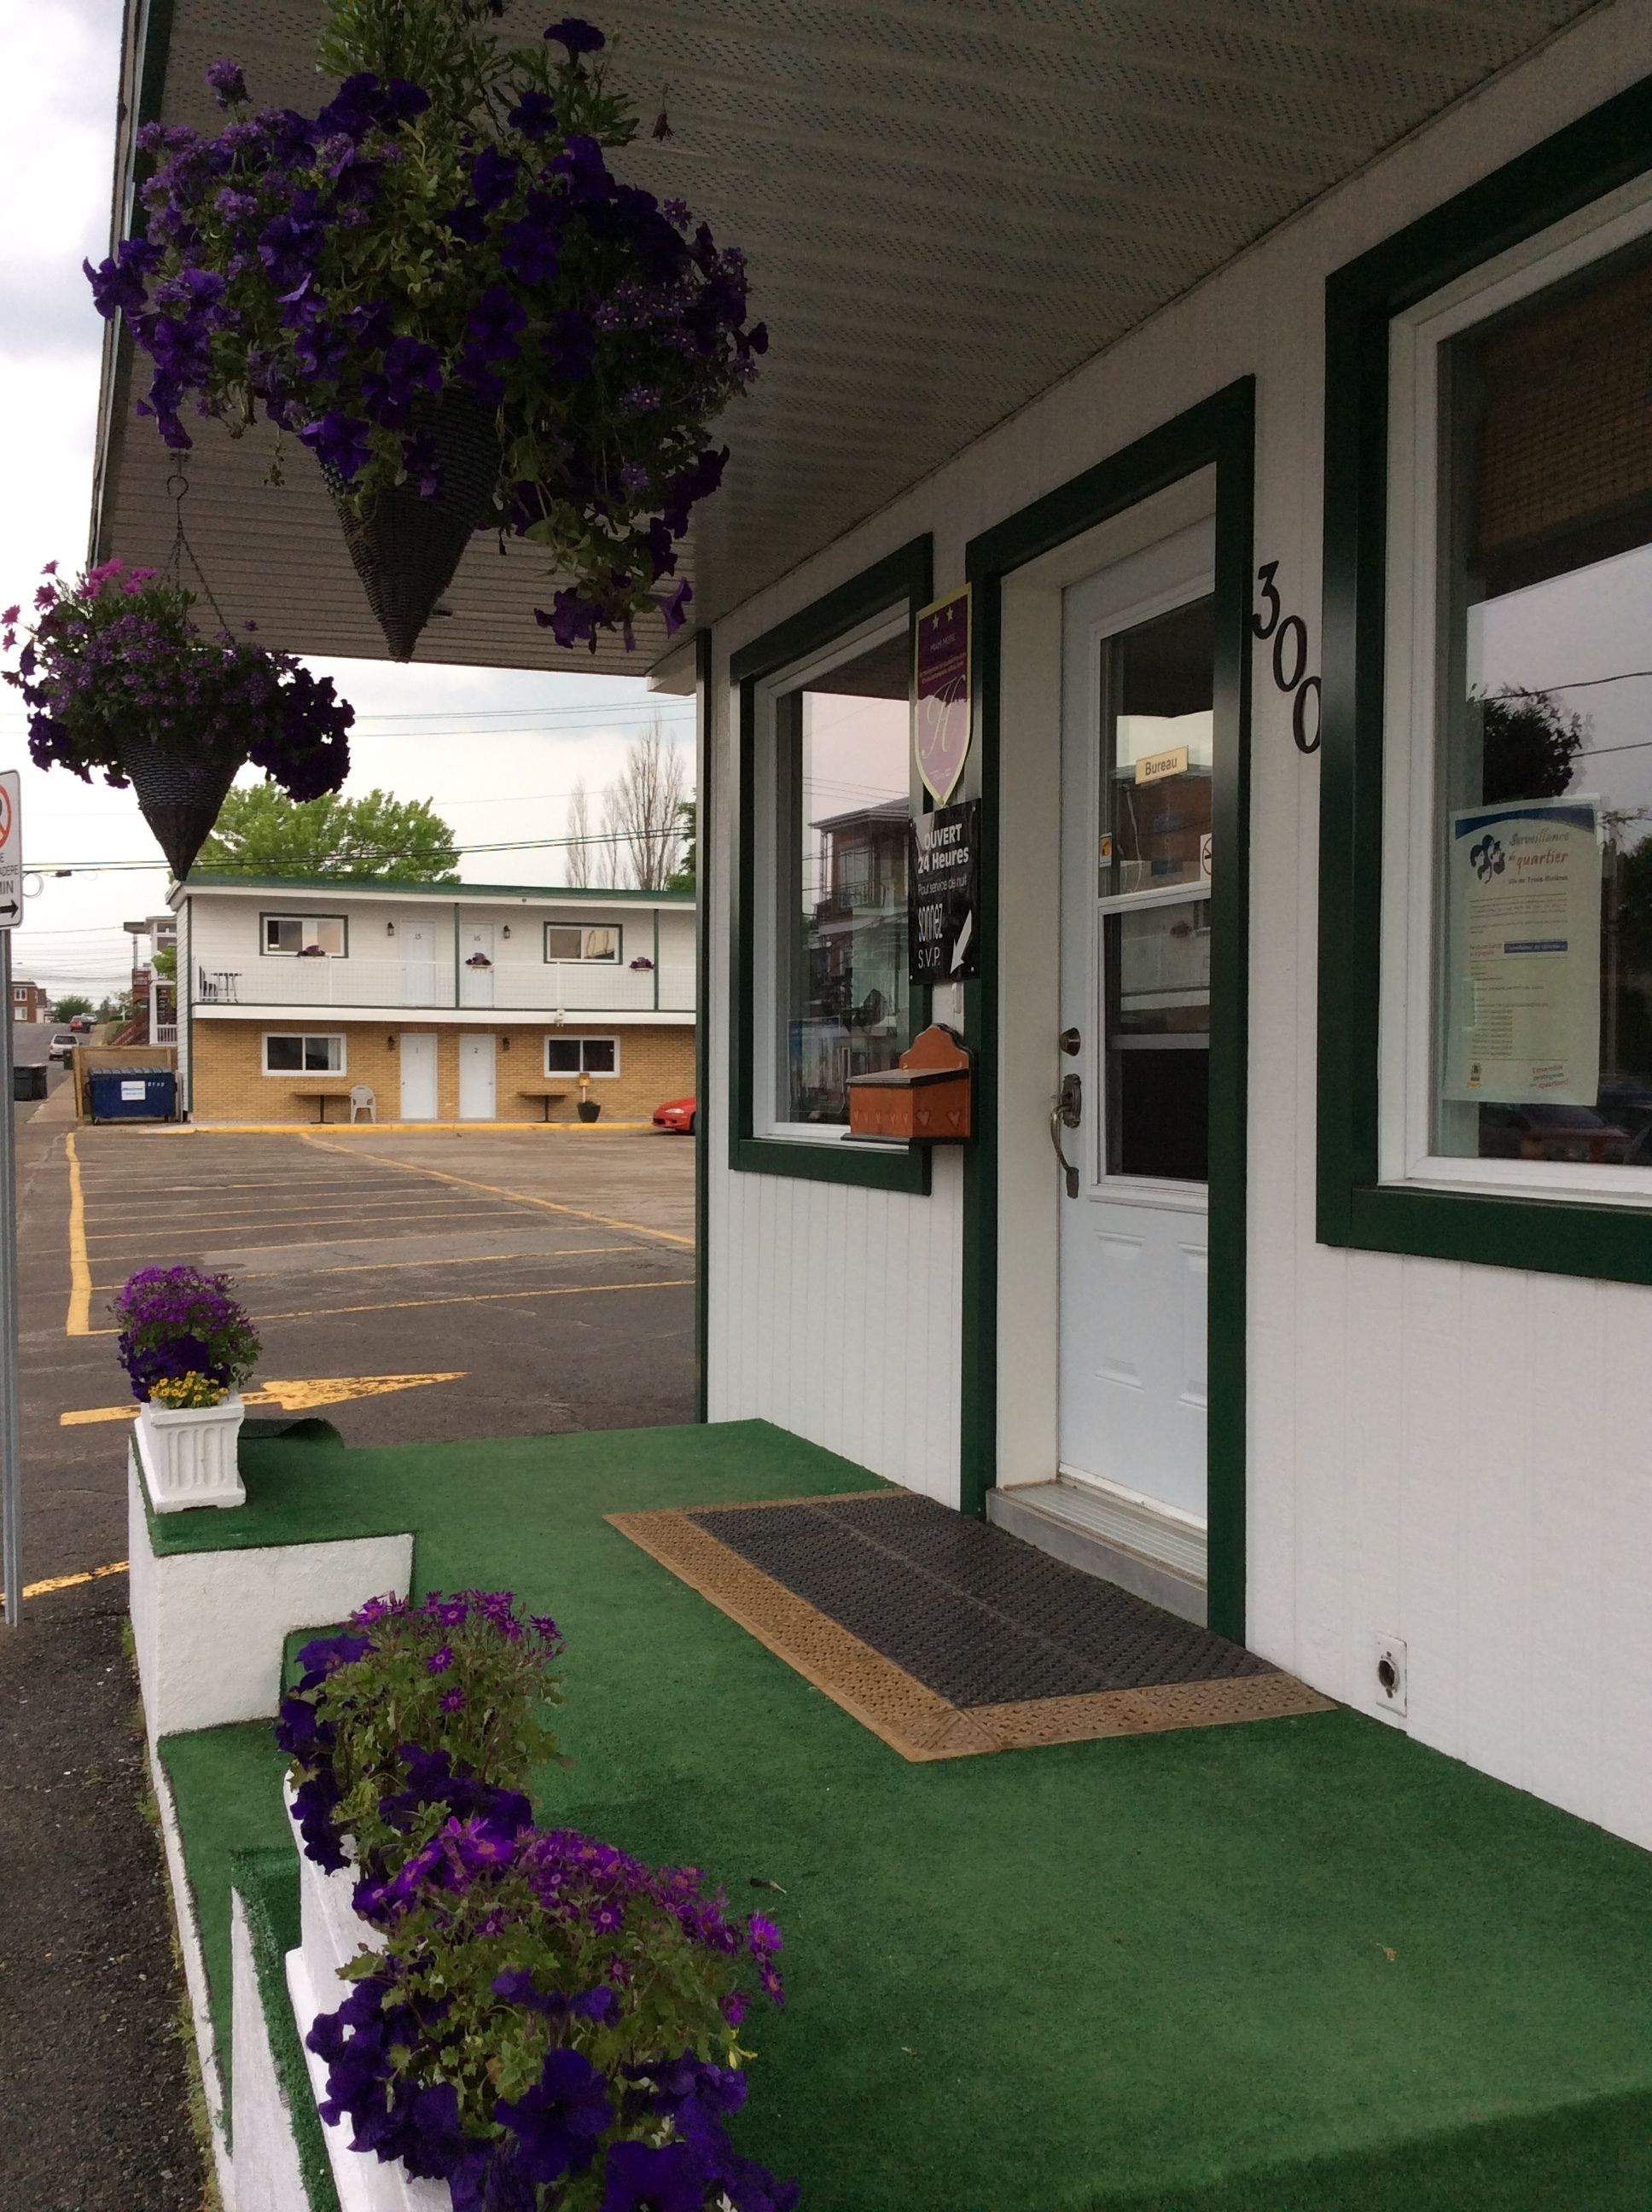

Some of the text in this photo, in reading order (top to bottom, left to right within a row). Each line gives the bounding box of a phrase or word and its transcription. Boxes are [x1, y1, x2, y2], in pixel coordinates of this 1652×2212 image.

[1252, 560, 1322, 754] 300
[1145, 757, 1178, 776] Bureau
[924, 823, 963, 851] OUVERT
[917, 847, 969, 874] 24 Heures
[1516, 848, 1569, 874] quartier
[948, 876, 956, 889] de
[956, 874, 968, 888] nuit
